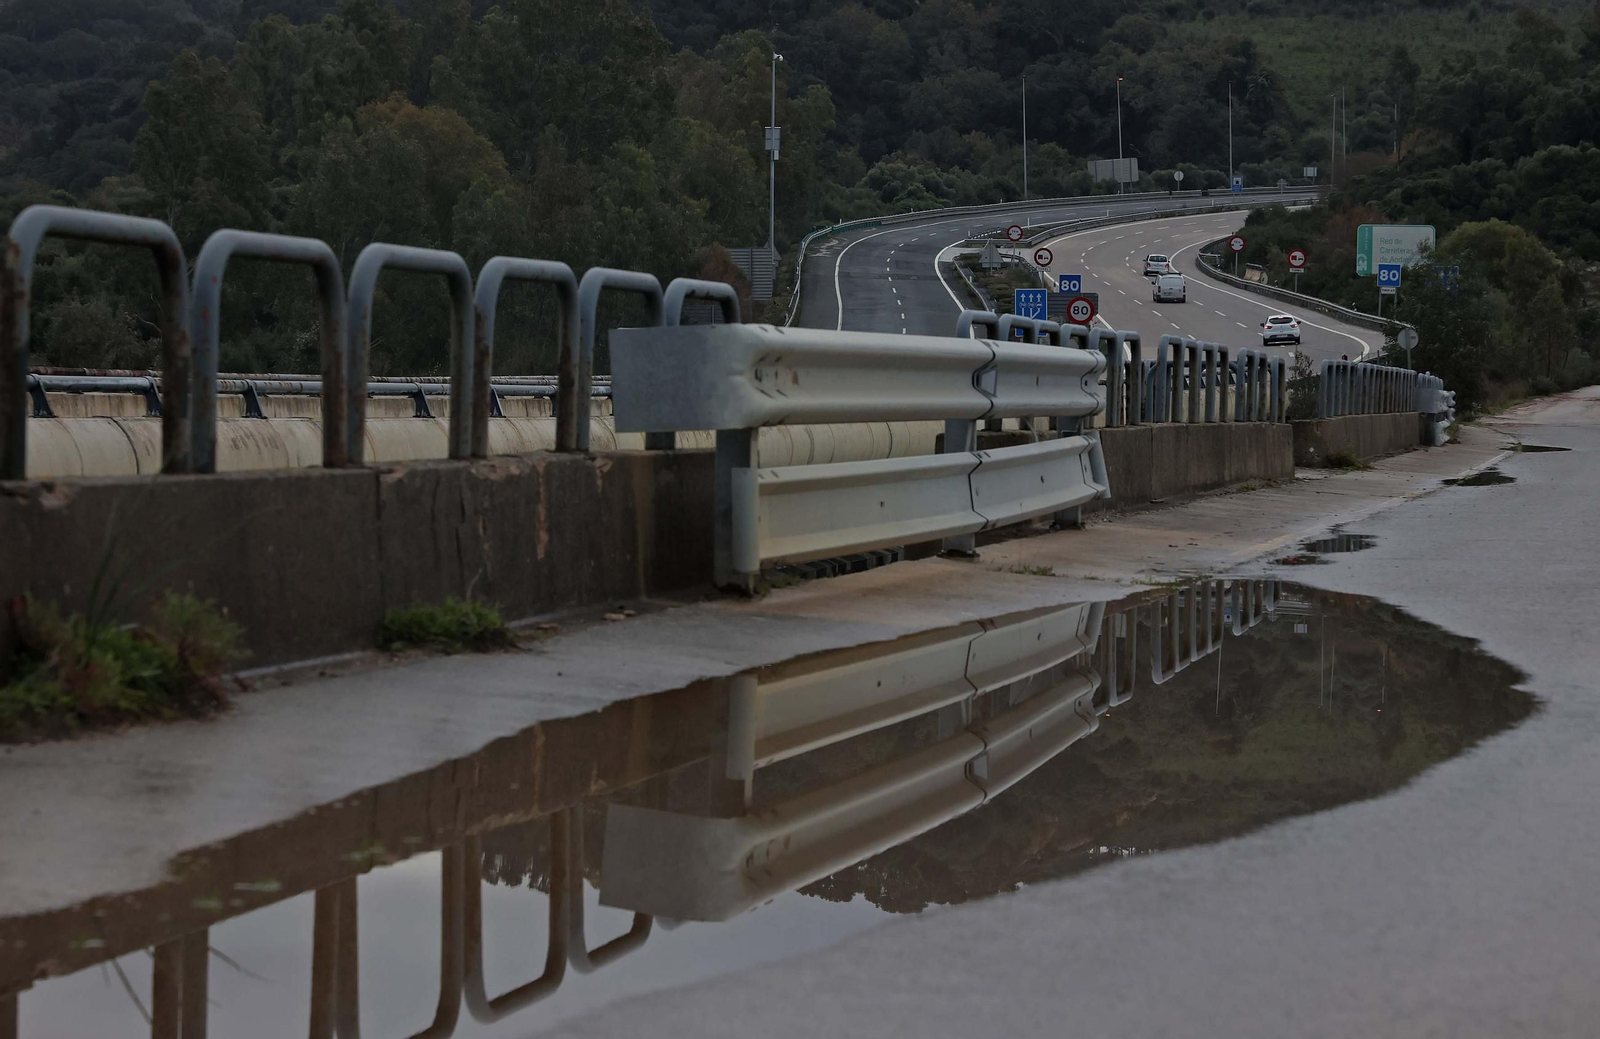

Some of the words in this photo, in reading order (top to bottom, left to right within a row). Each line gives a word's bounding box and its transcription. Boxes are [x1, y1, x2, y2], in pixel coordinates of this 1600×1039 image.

[1380, 270, 1399, 281] 80
[1061, 280, 1079, 291] 80
[1072, 306, 1089, 315] 80
